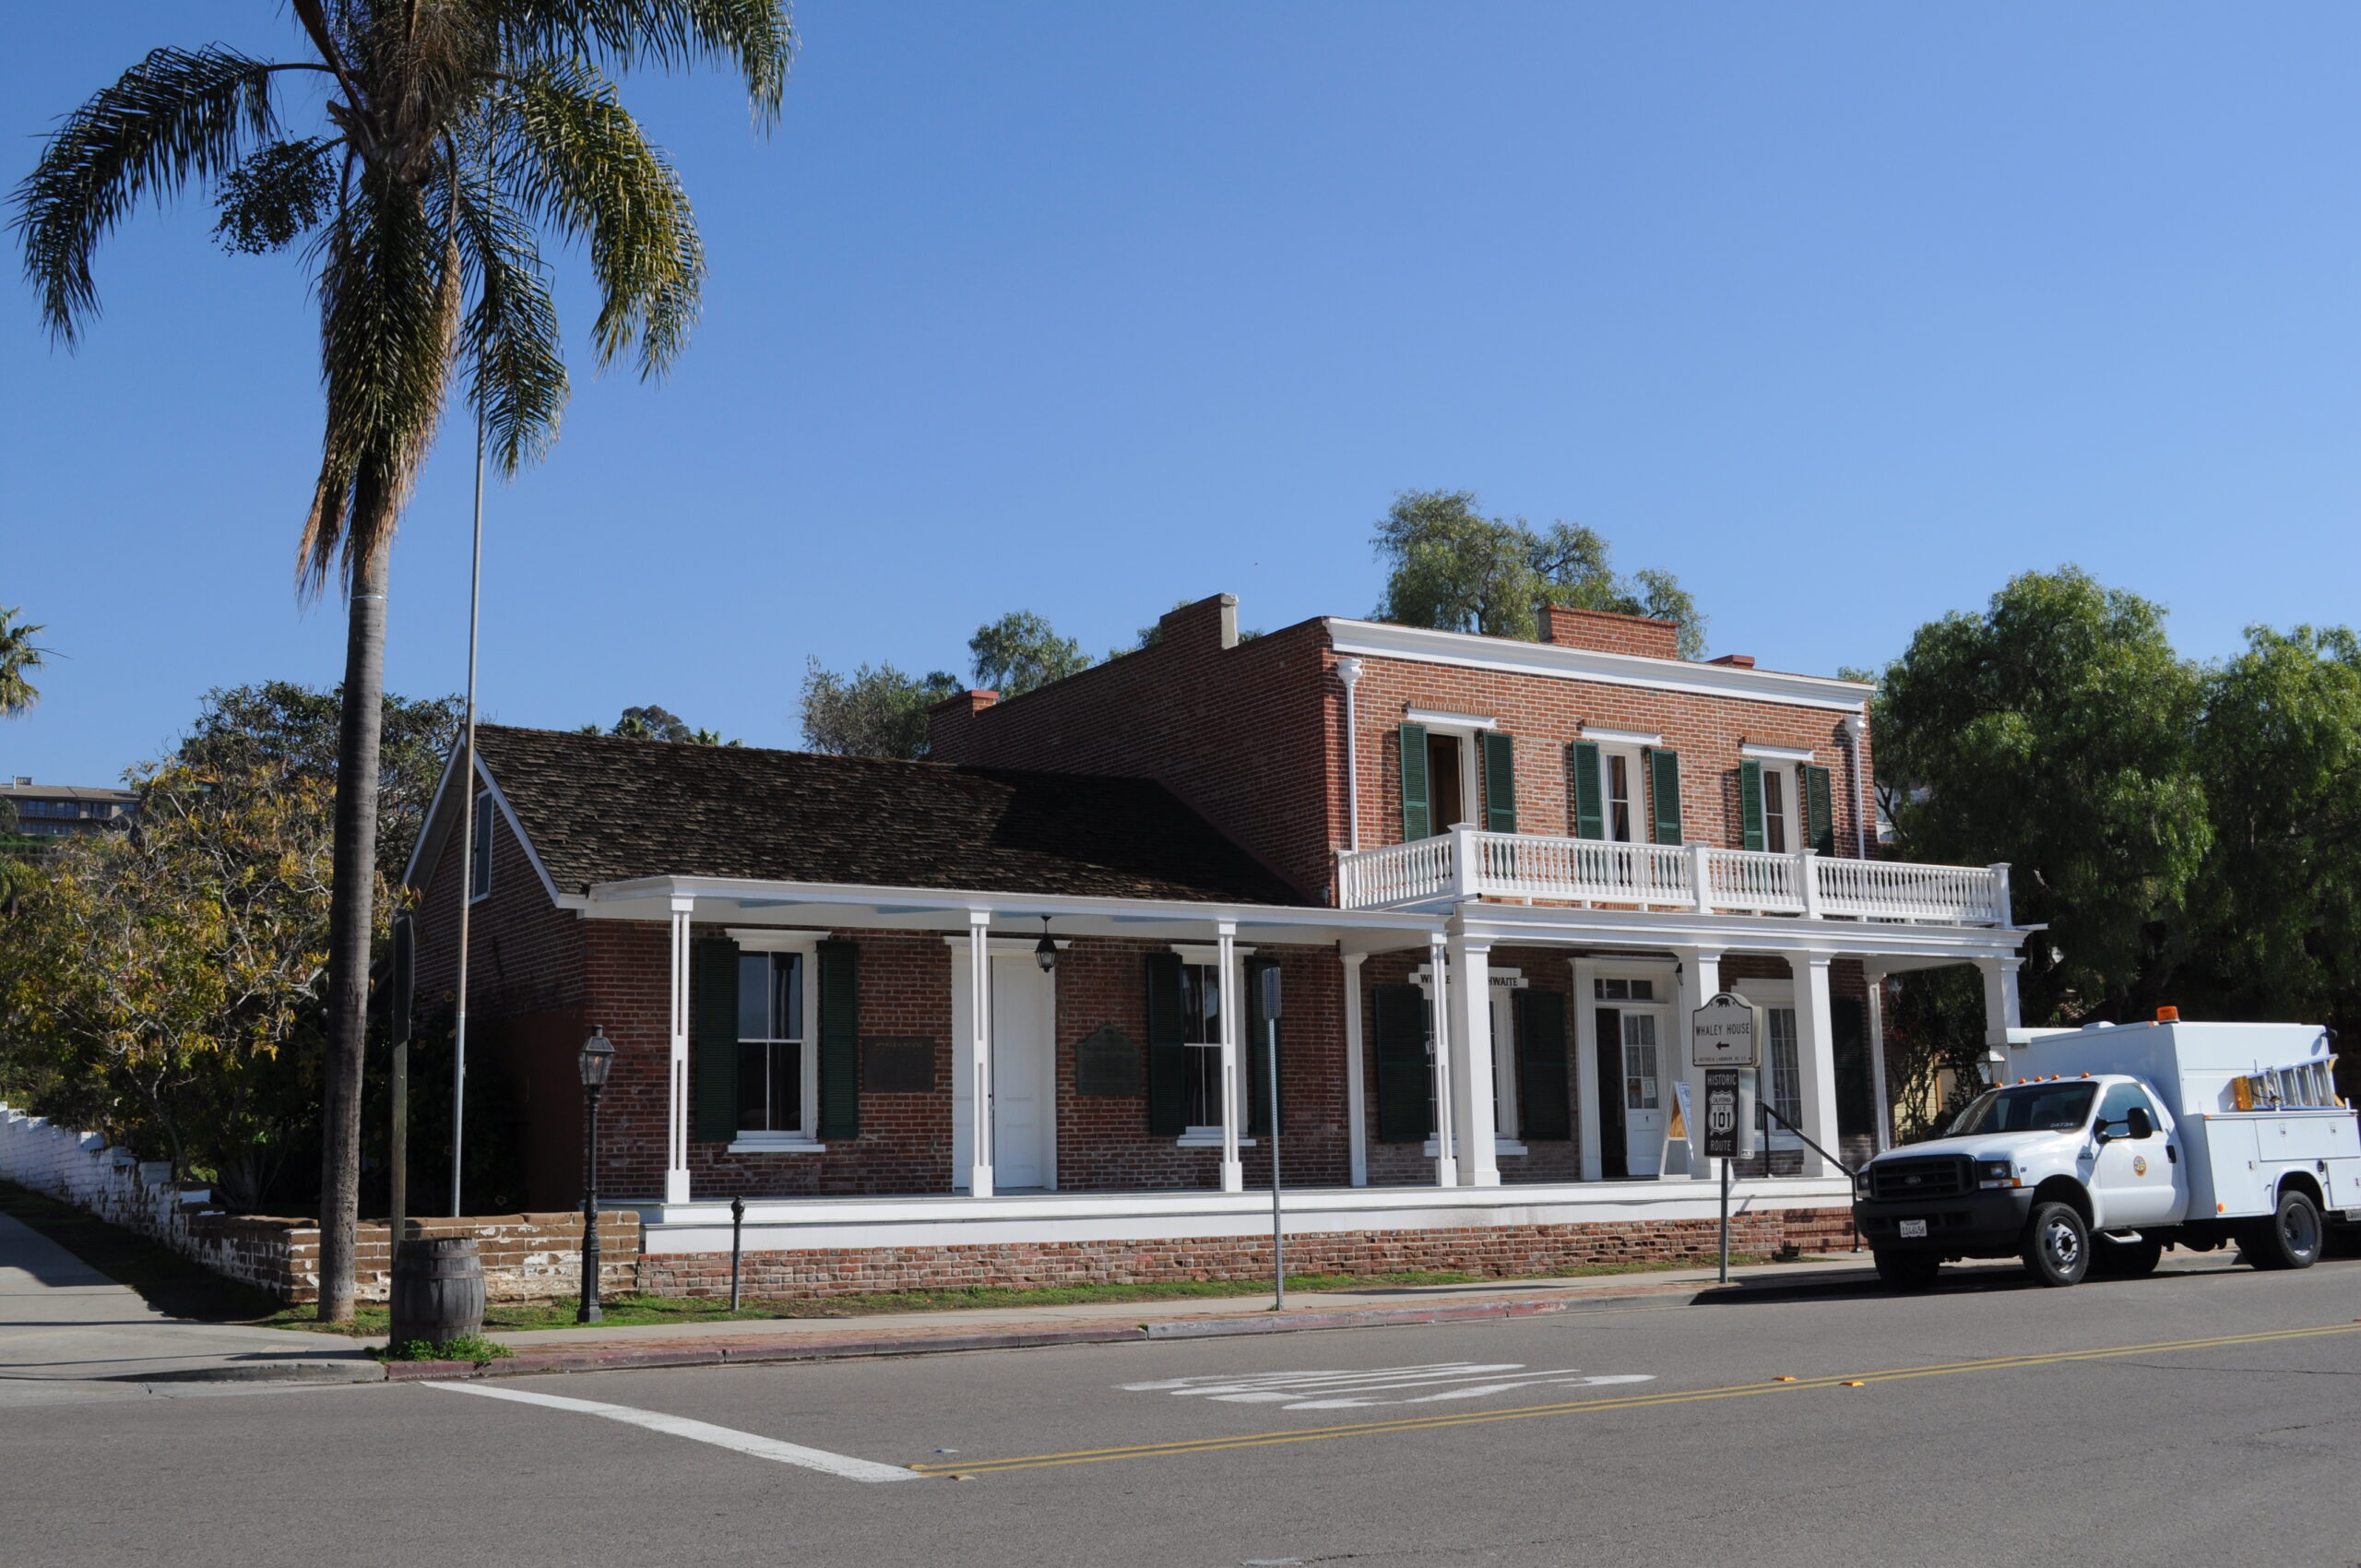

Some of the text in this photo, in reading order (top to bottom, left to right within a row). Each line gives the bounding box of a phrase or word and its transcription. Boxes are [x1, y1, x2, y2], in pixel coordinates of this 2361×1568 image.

[1696, 1023, 1750, 1036] WHALEY HOUSE
[1707, 1074, 1737, 1085] HISTORIC
[1713, 1111, 1730, 1127] 101
[1711, 1140, 1731, 1151] ROUTE
